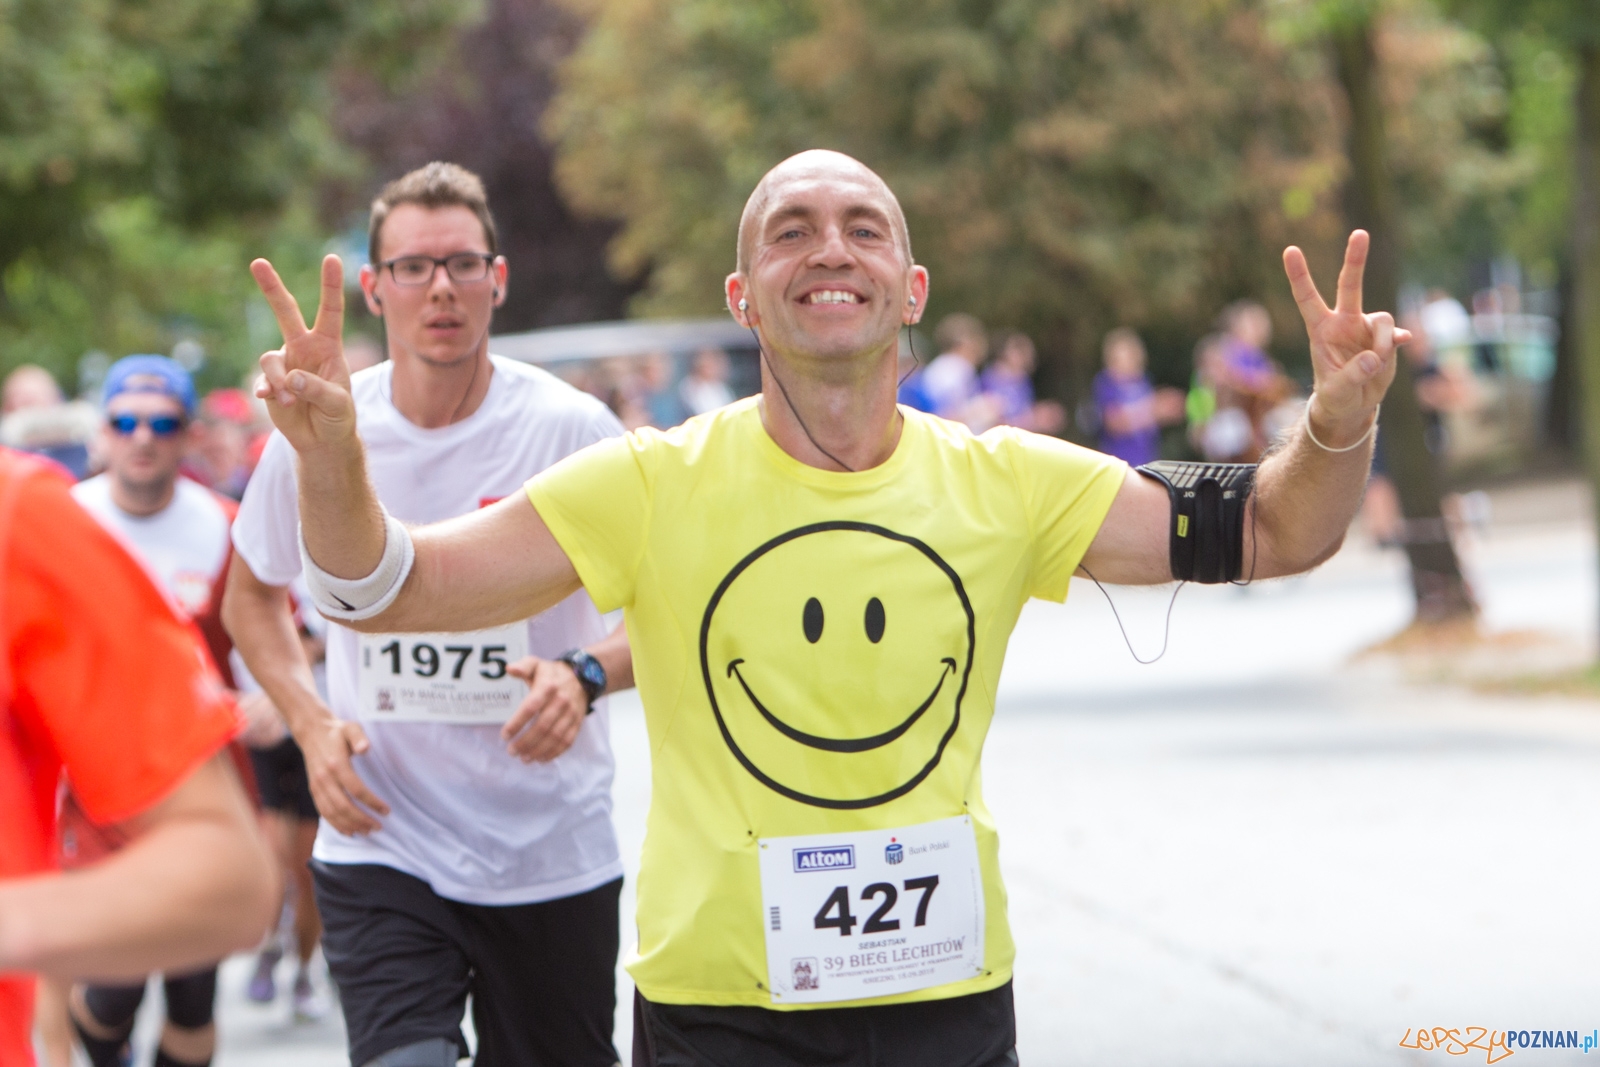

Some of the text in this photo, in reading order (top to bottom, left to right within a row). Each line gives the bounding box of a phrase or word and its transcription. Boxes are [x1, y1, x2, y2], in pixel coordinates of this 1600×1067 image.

[381, 640, 508, 679] 1975
[908, 840, 950, 856] Bank Polski
[814, 875, 939, 937] 427
[823, 935, 966, 971] 39 BIEG LECHITÓW
[858, 937, 907, 950] SEBASTIAN
